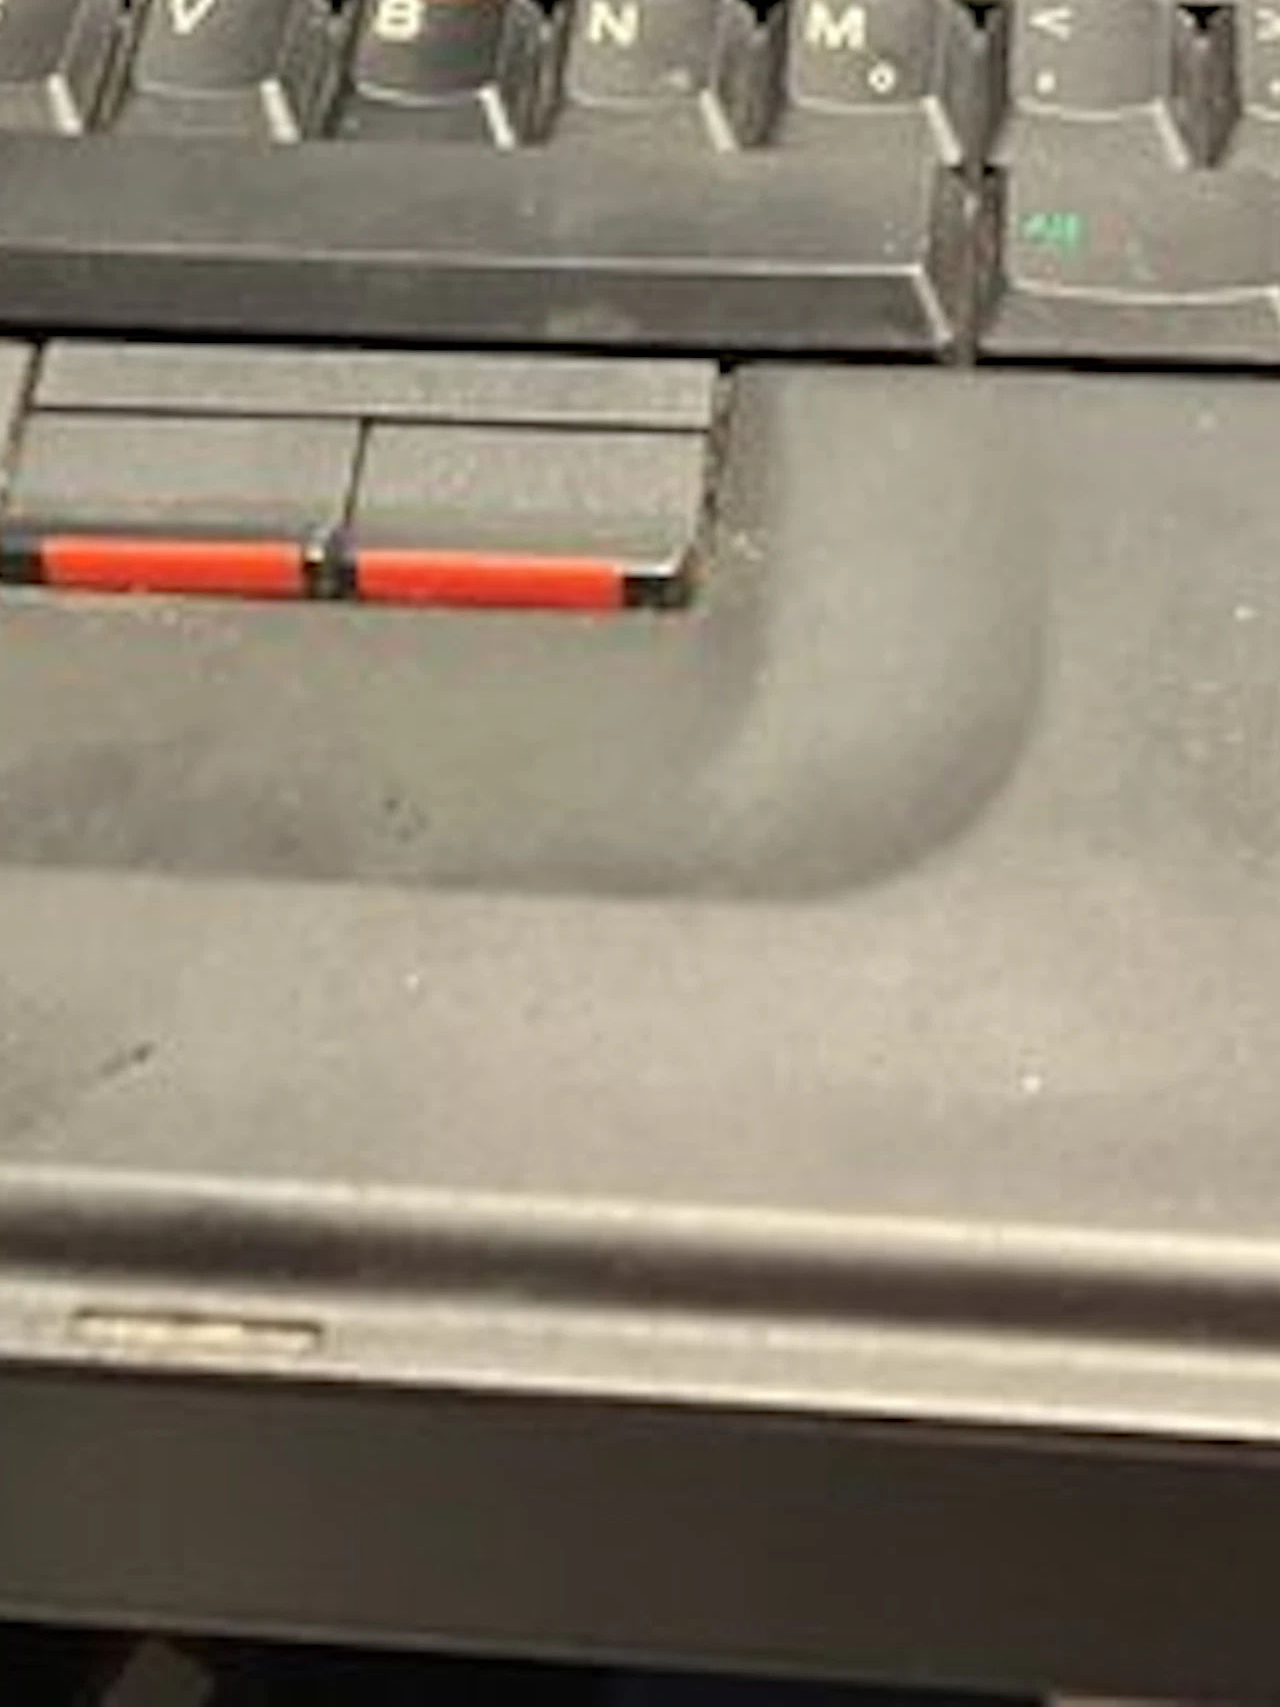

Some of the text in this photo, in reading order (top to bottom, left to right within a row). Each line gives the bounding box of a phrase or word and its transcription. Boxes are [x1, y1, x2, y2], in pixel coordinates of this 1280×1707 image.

[586, 0, 639, 46] N
[805, 0, 866, 49] M
[1022, 213, 1079, 248] Alt
